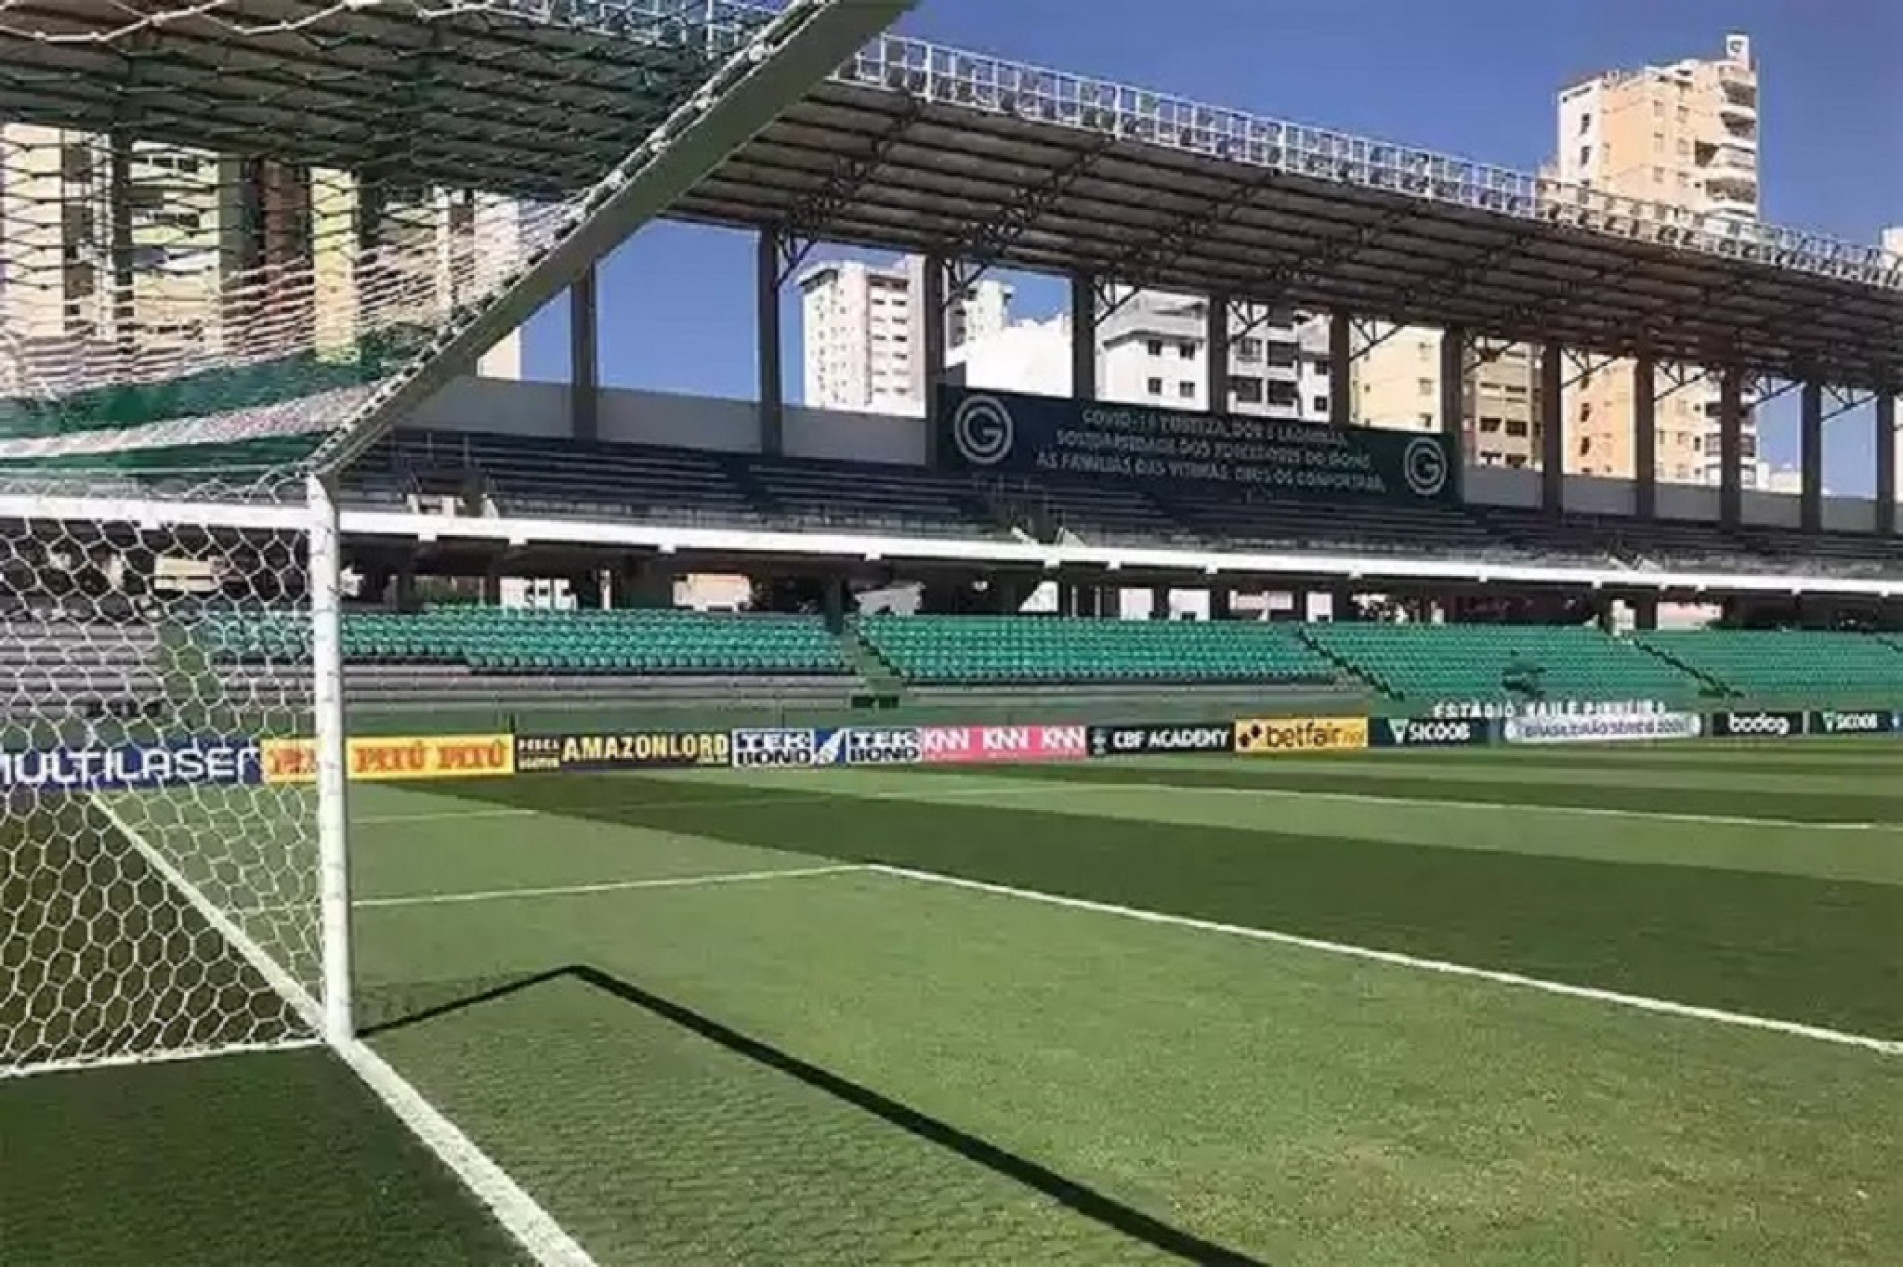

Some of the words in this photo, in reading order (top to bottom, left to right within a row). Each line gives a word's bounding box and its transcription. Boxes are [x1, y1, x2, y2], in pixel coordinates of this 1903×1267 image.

[1408, 722, 1471, 741] SICOOB
[1728, 711, 1790, 735] bodog
[741, 732, 811, 748] TEK
[853, 731, 917, 746] TEK
[924, 726, 970, 751] KNN
[982, 726, 1029, 750] KNN
[1042, 725, 1086, 749] KNN
[1113, 731, 1146, 748] CBF
[1148, 728, 1229, 748] ACADEMY
[561, 734, 729, 762] AMAZONLORD
[738, 749, 811, 764] BOND
